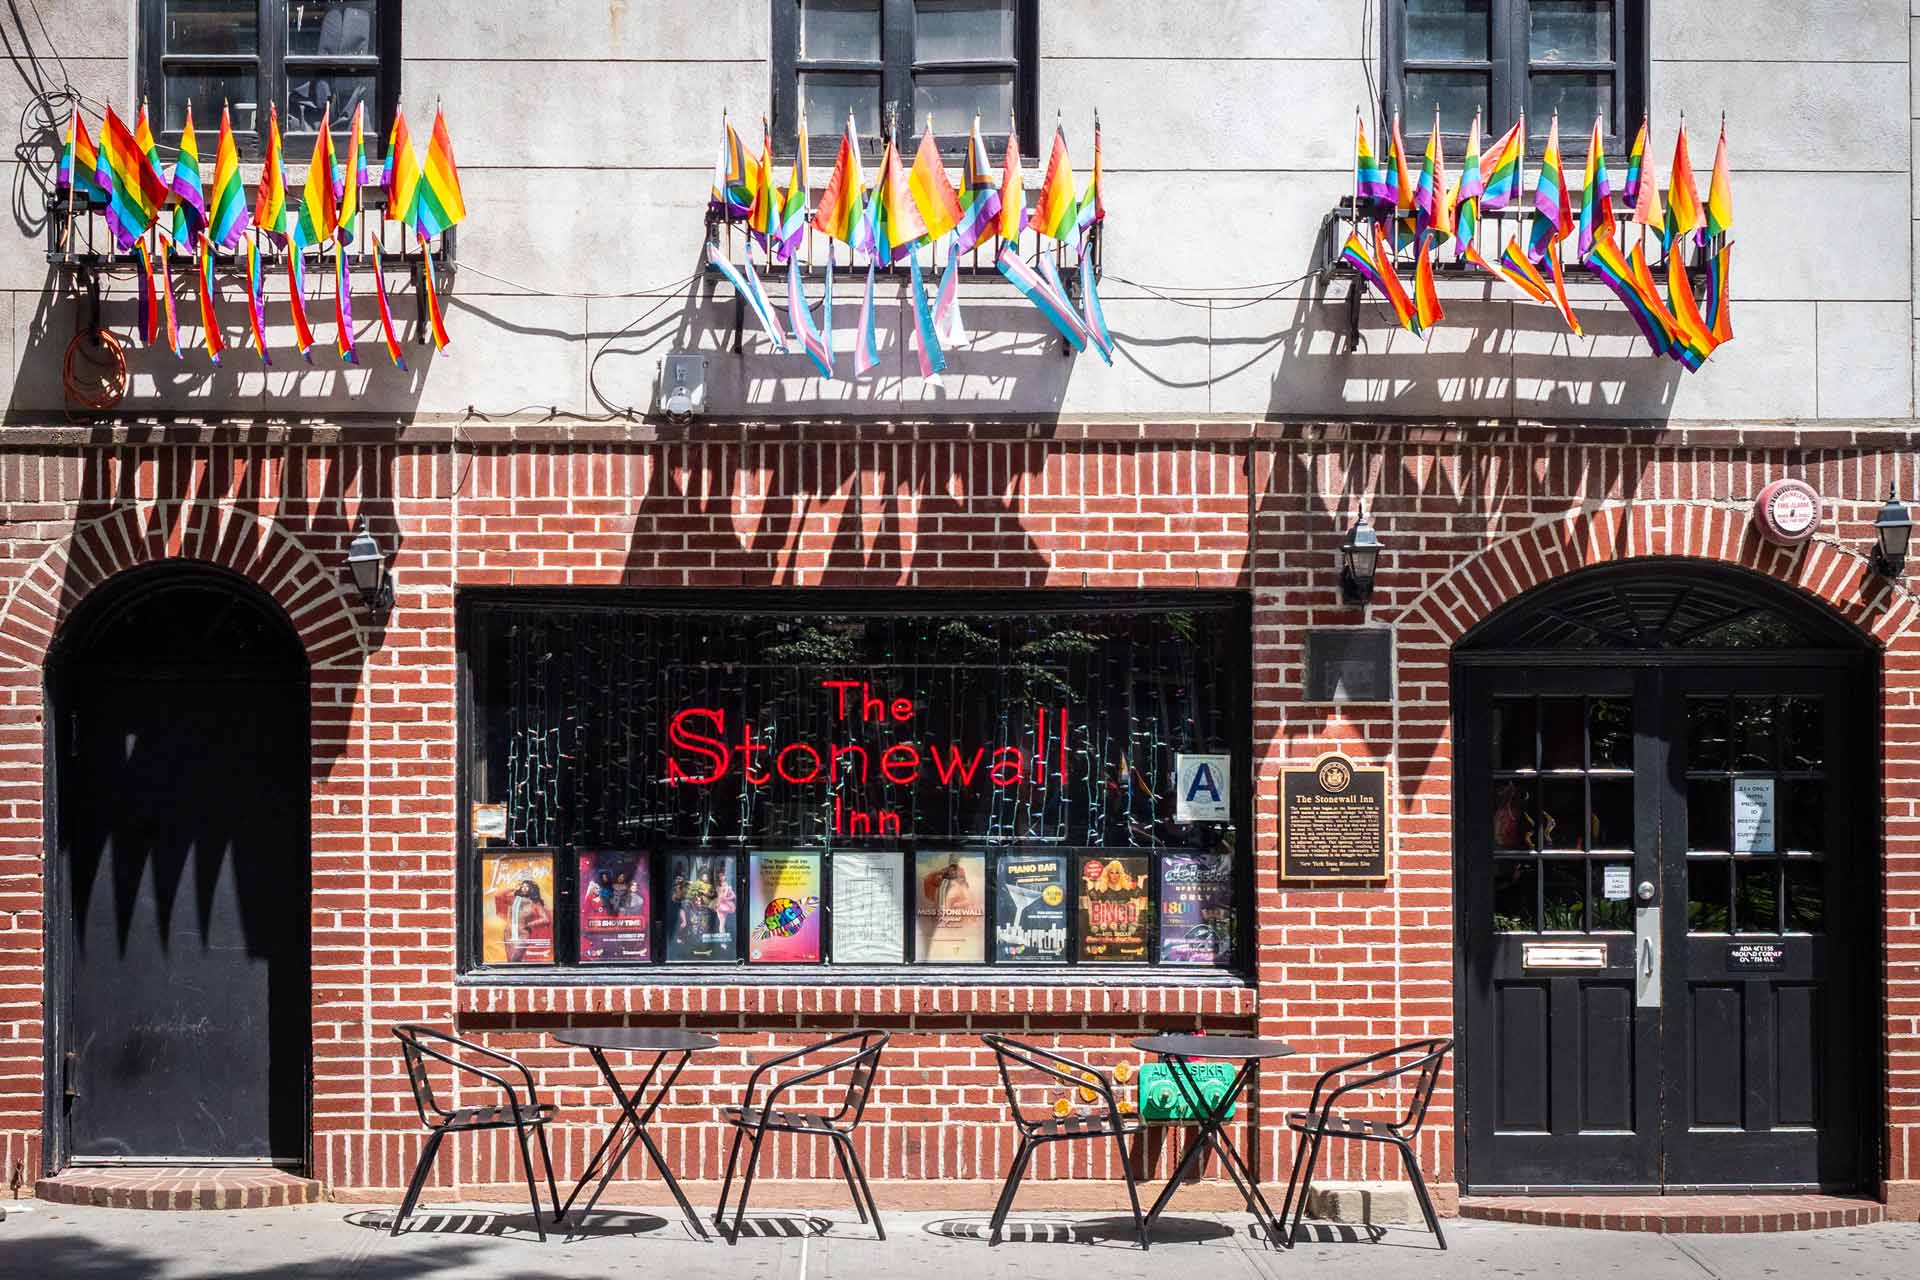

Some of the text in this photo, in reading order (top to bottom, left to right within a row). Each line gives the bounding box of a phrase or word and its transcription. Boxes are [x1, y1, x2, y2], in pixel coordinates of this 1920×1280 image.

[823, 681, 913, 722] The
[668, 708, 1067, 787] Stonewall
[1186, 763, 1222, 802] A
[1295, 794, 1375, 804] The Stonewall Inn
[835, 795, 900, 837] Inn
[1007, 863, 1057, 874] PIANO BAR
[938, 908, 983, 917] STONEWALL
[1090, 901, 1137, 925] BINGO
[602, 919, 624, 927] SHOW
[625, 919, 642, 927] TIME
[1191, 1065, 1224, 1076] SPKR
